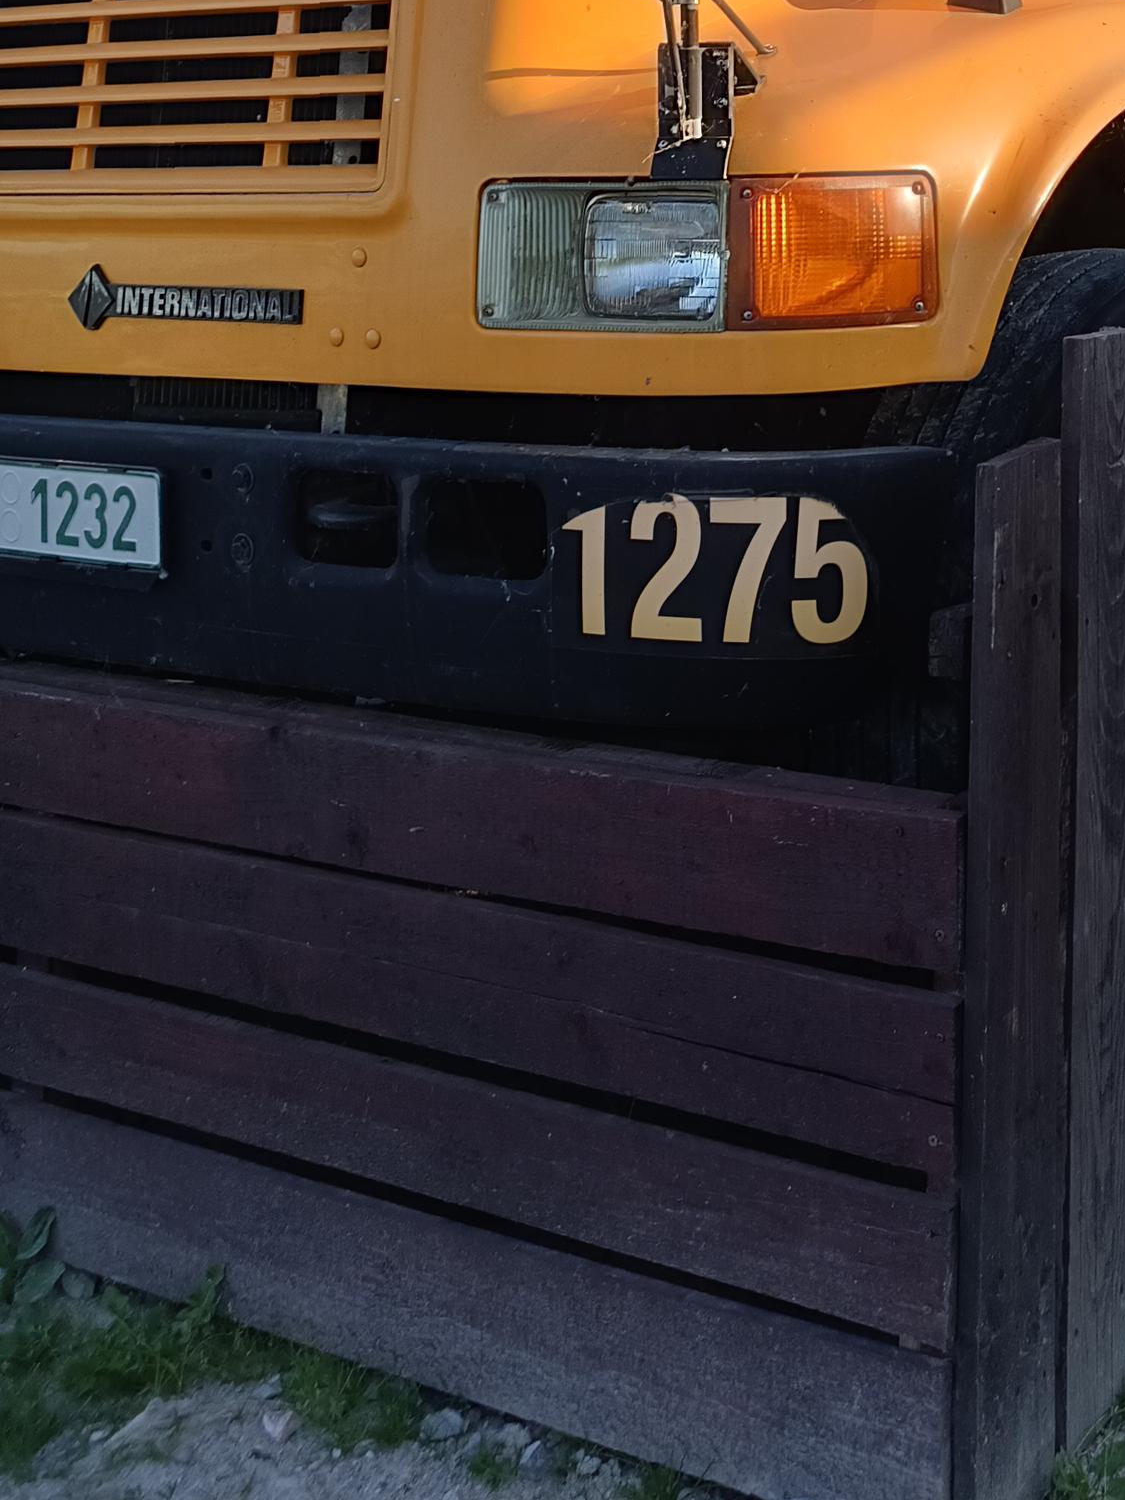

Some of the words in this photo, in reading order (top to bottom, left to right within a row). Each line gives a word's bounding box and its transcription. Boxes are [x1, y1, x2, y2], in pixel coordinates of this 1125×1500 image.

[115, 286, 300, 323] INTERNATIONAL
[31, 478, 137, 552] 1232
[562, 493, 868, 644] 1275
